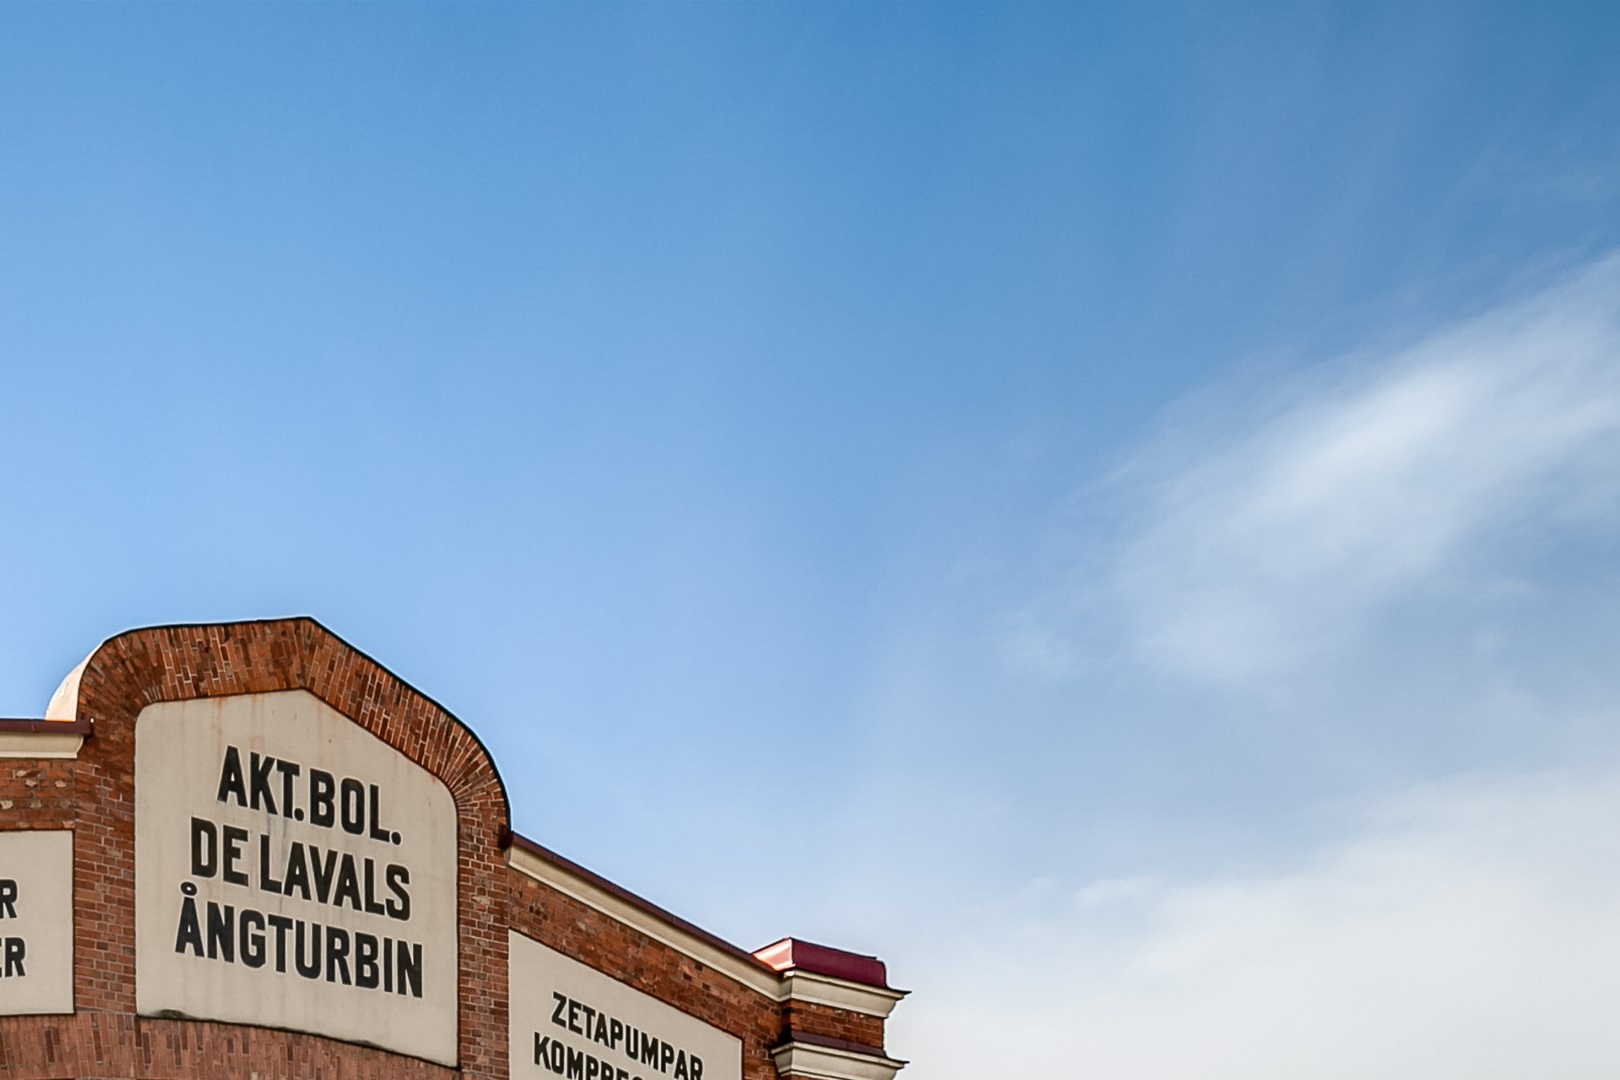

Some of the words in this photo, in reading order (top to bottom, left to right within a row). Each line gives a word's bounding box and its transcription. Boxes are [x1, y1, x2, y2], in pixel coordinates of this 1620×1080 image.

[191, 816, 249, 887] DE
[260, 834, 411, 921] LAVALS
[175, 881, 423, 999] ÅNGTURBIN
